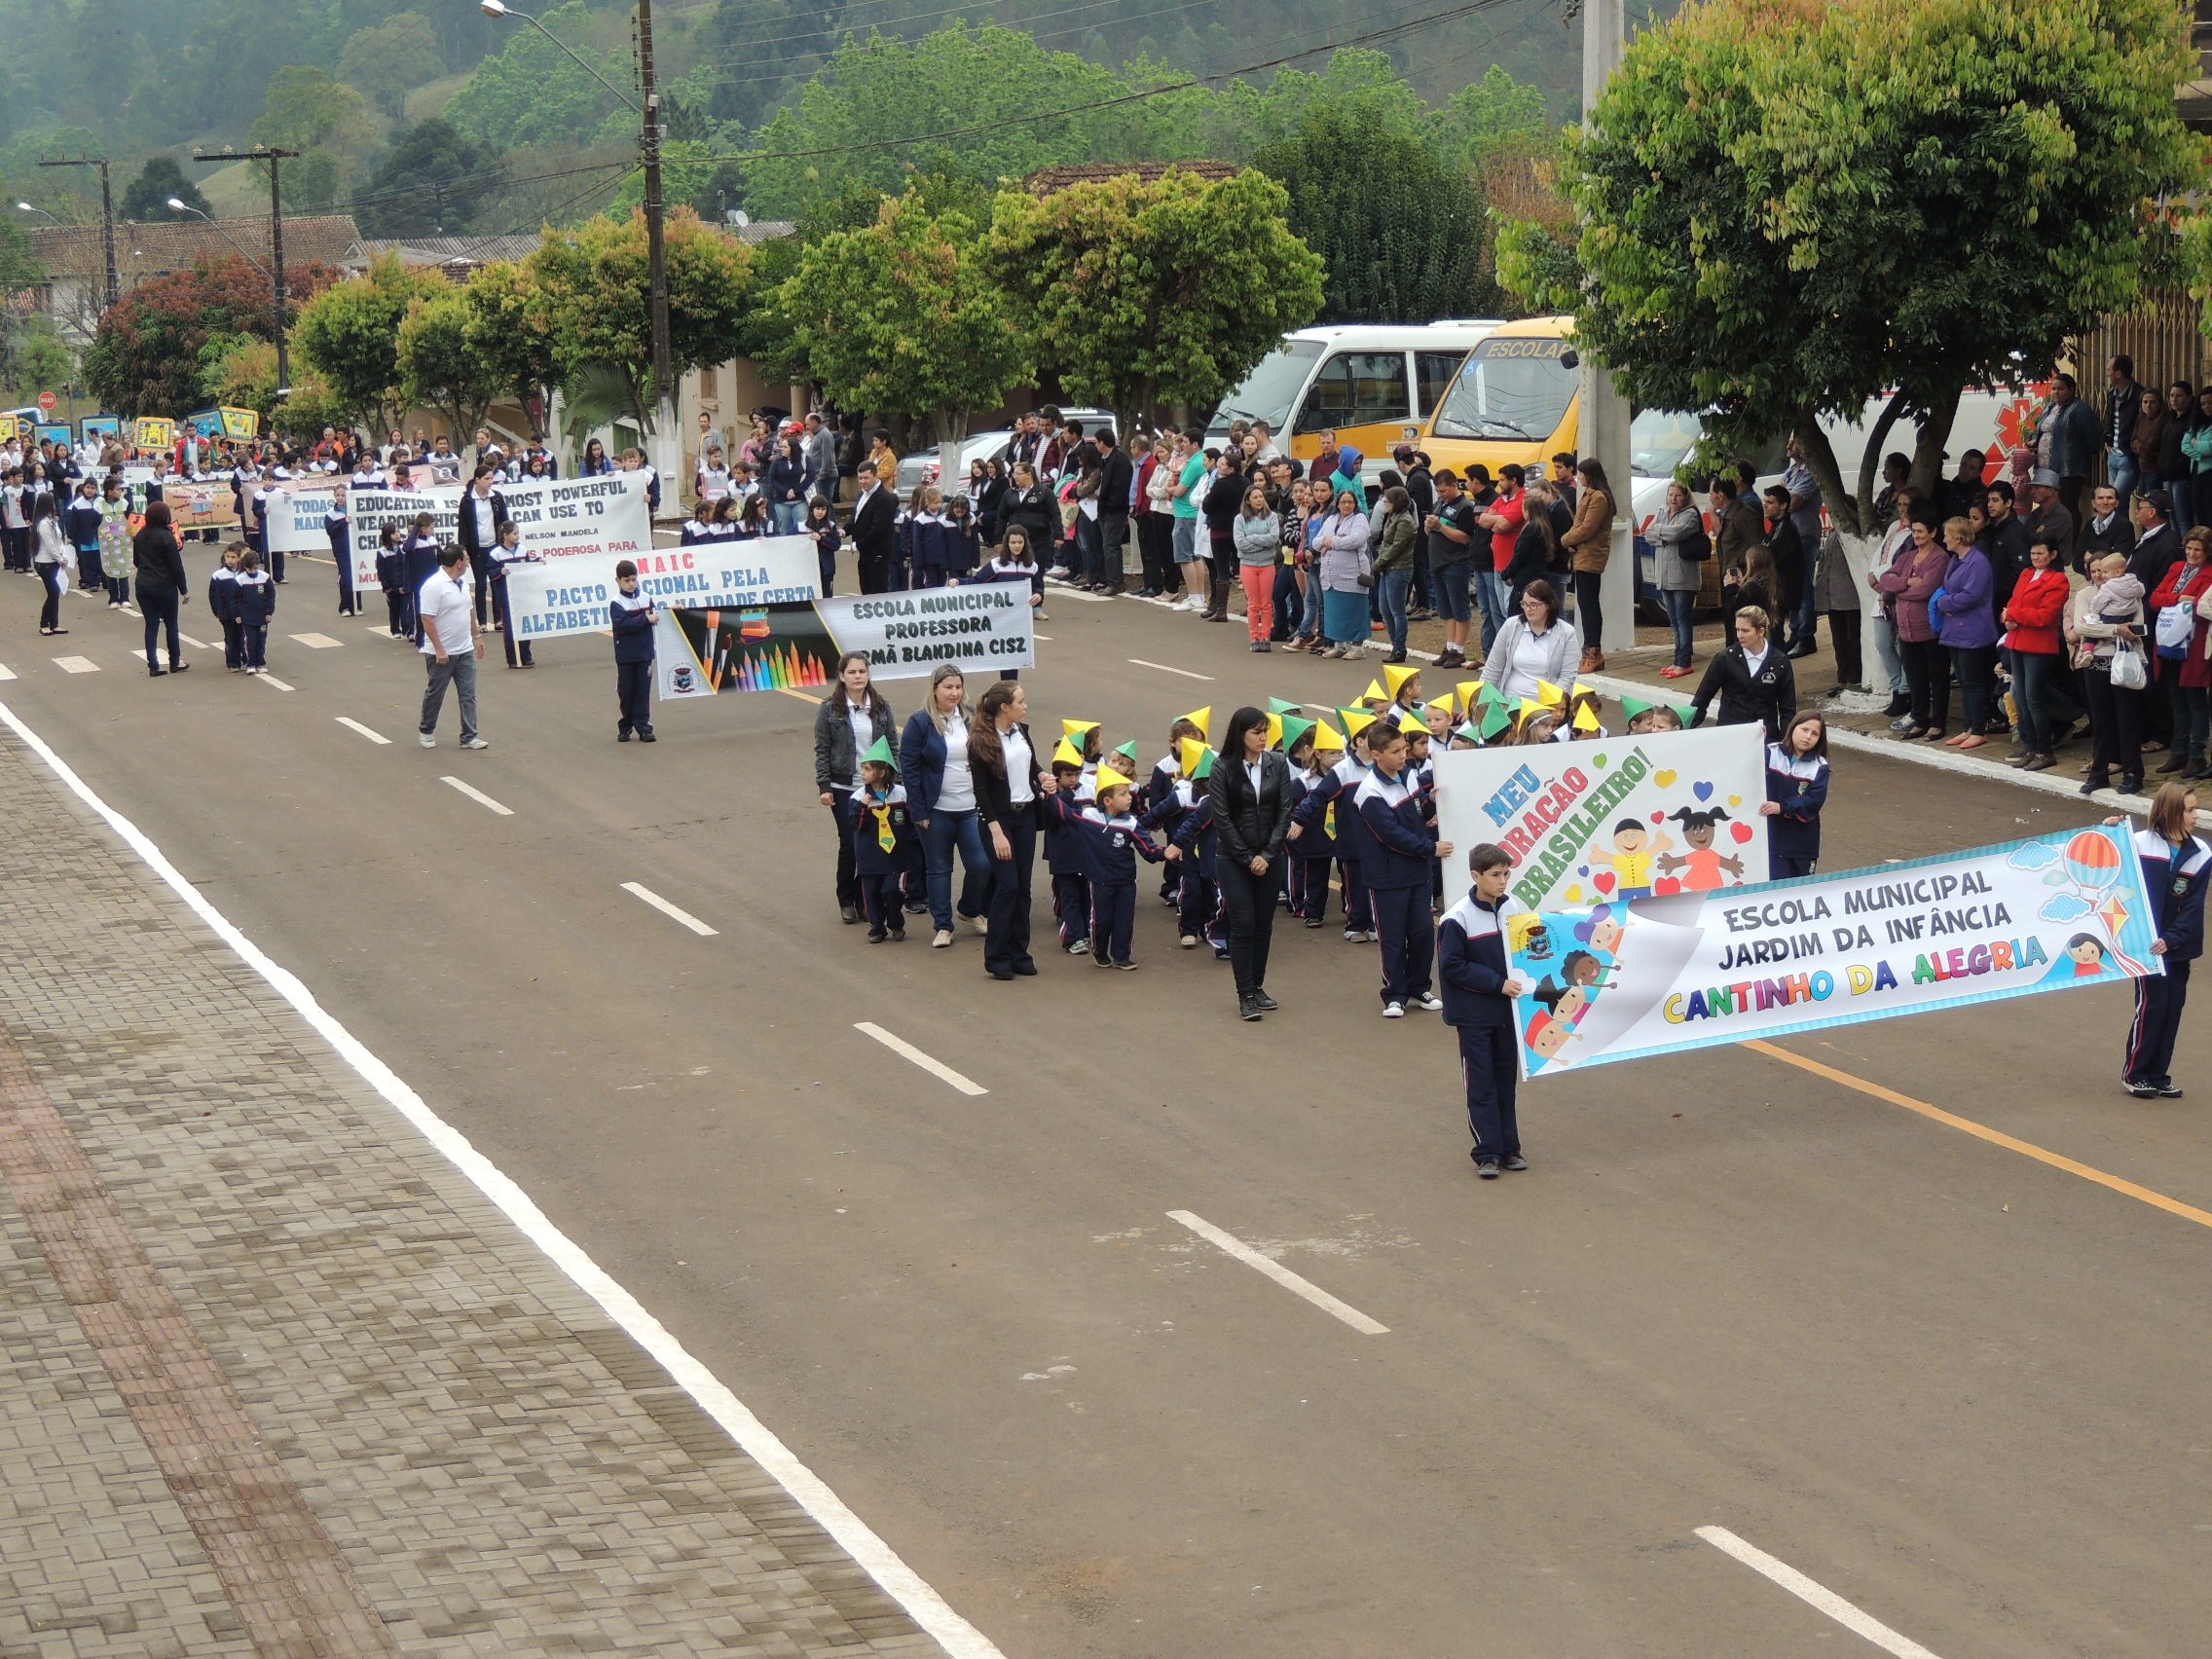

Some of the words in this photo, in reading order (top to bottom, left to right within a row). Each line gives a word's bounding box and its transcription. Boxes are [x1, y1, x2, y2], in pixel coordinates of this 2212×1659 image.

[355, 497, 435, 512] EDUCATION
[444, 499, 459, 509] IS
[504, 491, 542, 508] MOST
[552, 481, 628, 502] POWERFUL
[294, 516, 326, 531] MAIO
[512, 509, 542, 524] CAN
[549, 504, 577, 520] USE
[585, 500, 605, 516] TO
[525, 532, 556, 540] NELSON
[560, 528, 600, 537] MANDELA
[542, 544, 602, 558] PODEROSA
[608, 540, 639, 552] PARA
[637, 552, 695, 574] NAIC
[545, 584, 608, 608] PACTO
[643, 573, 710, 596] CIONAL
[721, 567, 770, 588] PELA
[853, 599, 916, 619] ESCOLA
[920, 591, 1014, 614] MUNICIPAL
[885, 615, 992, 640] PROFESSORA
[902, 641, 984, 663] BLANDINA
[989, 637, 1027, 655] CISZ
[1481, 762, 1540, 829] MEU
[1496, 766, 1589, 869] ORAÇÃO
[1510, 745, 1654, 911] BRASILEIRO!
[1722, 896, 1832, 933] ESCOLA
[1844, 869, 1993, 915] MUNICIPAL
[1717, 932, 1824, 971] JARDIM
[1832, 924, 1875, 952] DA
[1885, 902, 2012, 944] INFÂNCIA
[1662, 970, 1834, 1024] CANTINHO
[1845, 960, 1899, 996] DA
[1911, 935, 2048, 985] ALEGRIA
